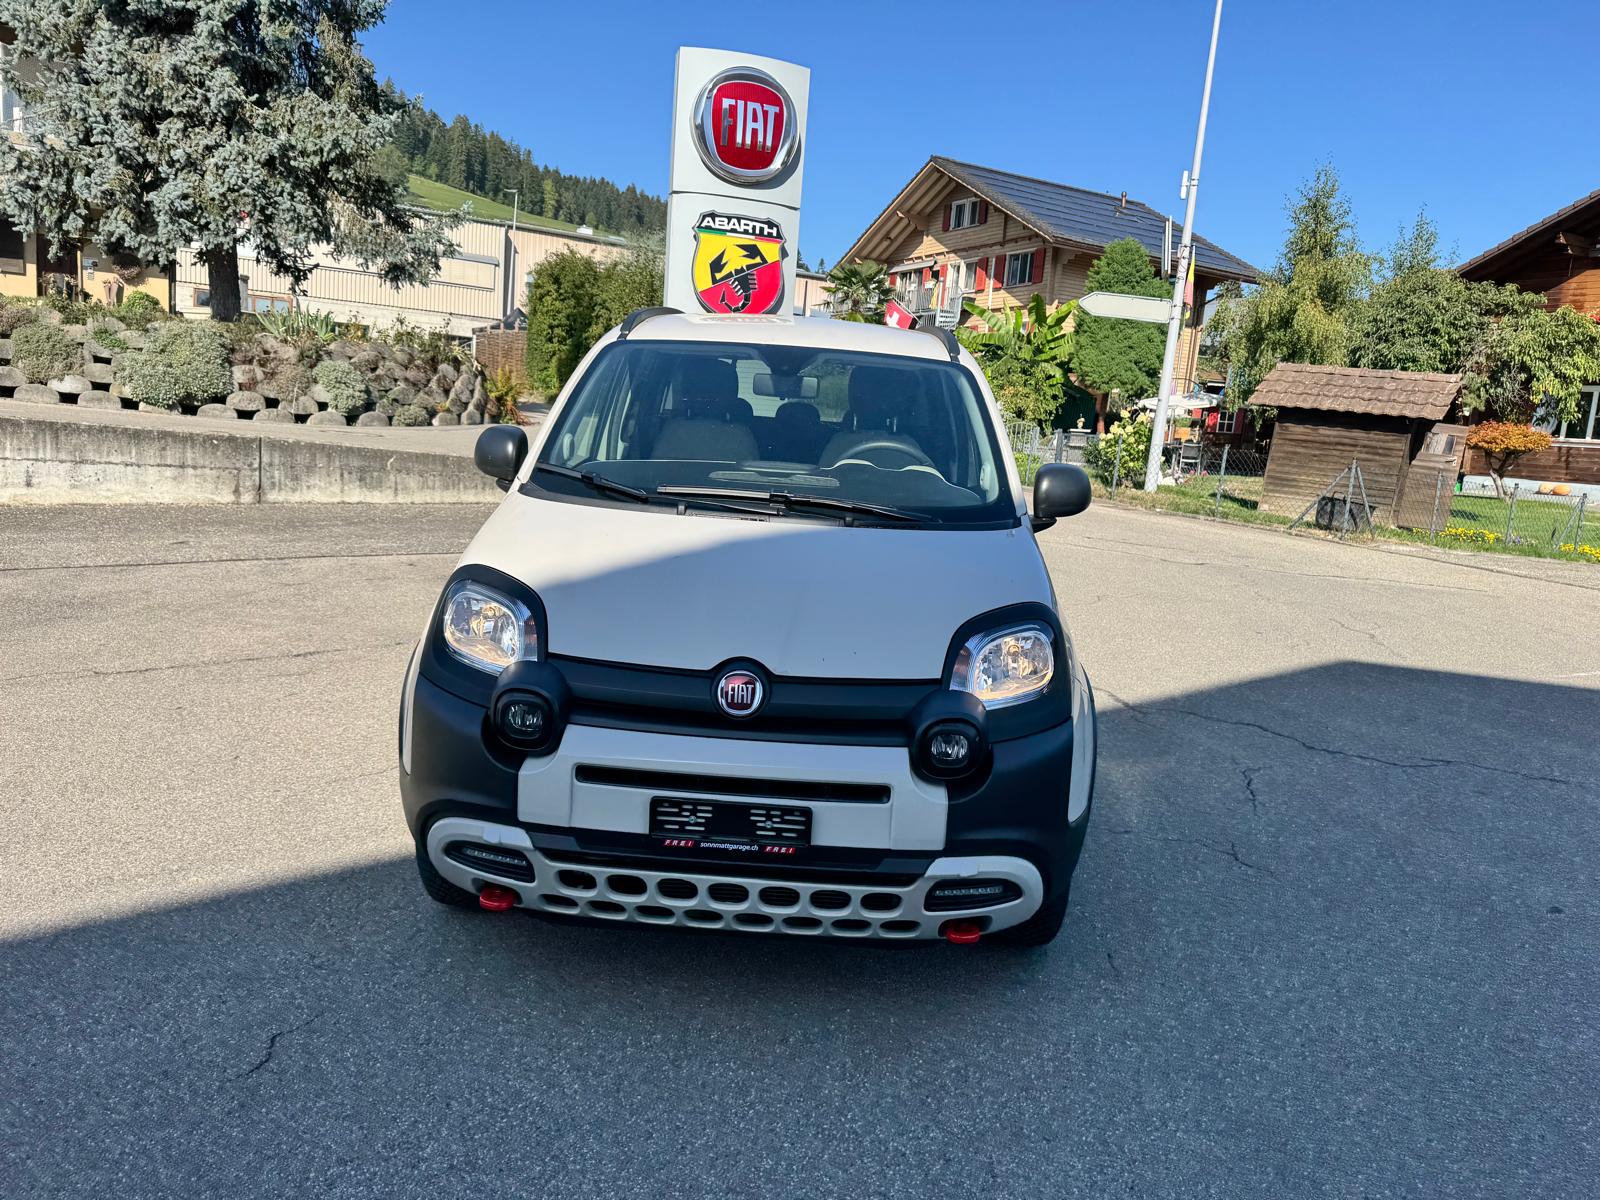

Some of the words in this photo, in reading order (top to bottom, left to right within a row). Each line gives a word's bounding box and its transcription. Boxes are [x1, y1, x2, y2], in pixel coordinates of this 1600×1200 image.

[720, 97, 780, 153] FIAT
[700, 216, 778, 237] ABARTH
[727, 683, 755, 704] FIAT
[700, 842, 759, 852] sonnmattgarage.ch
